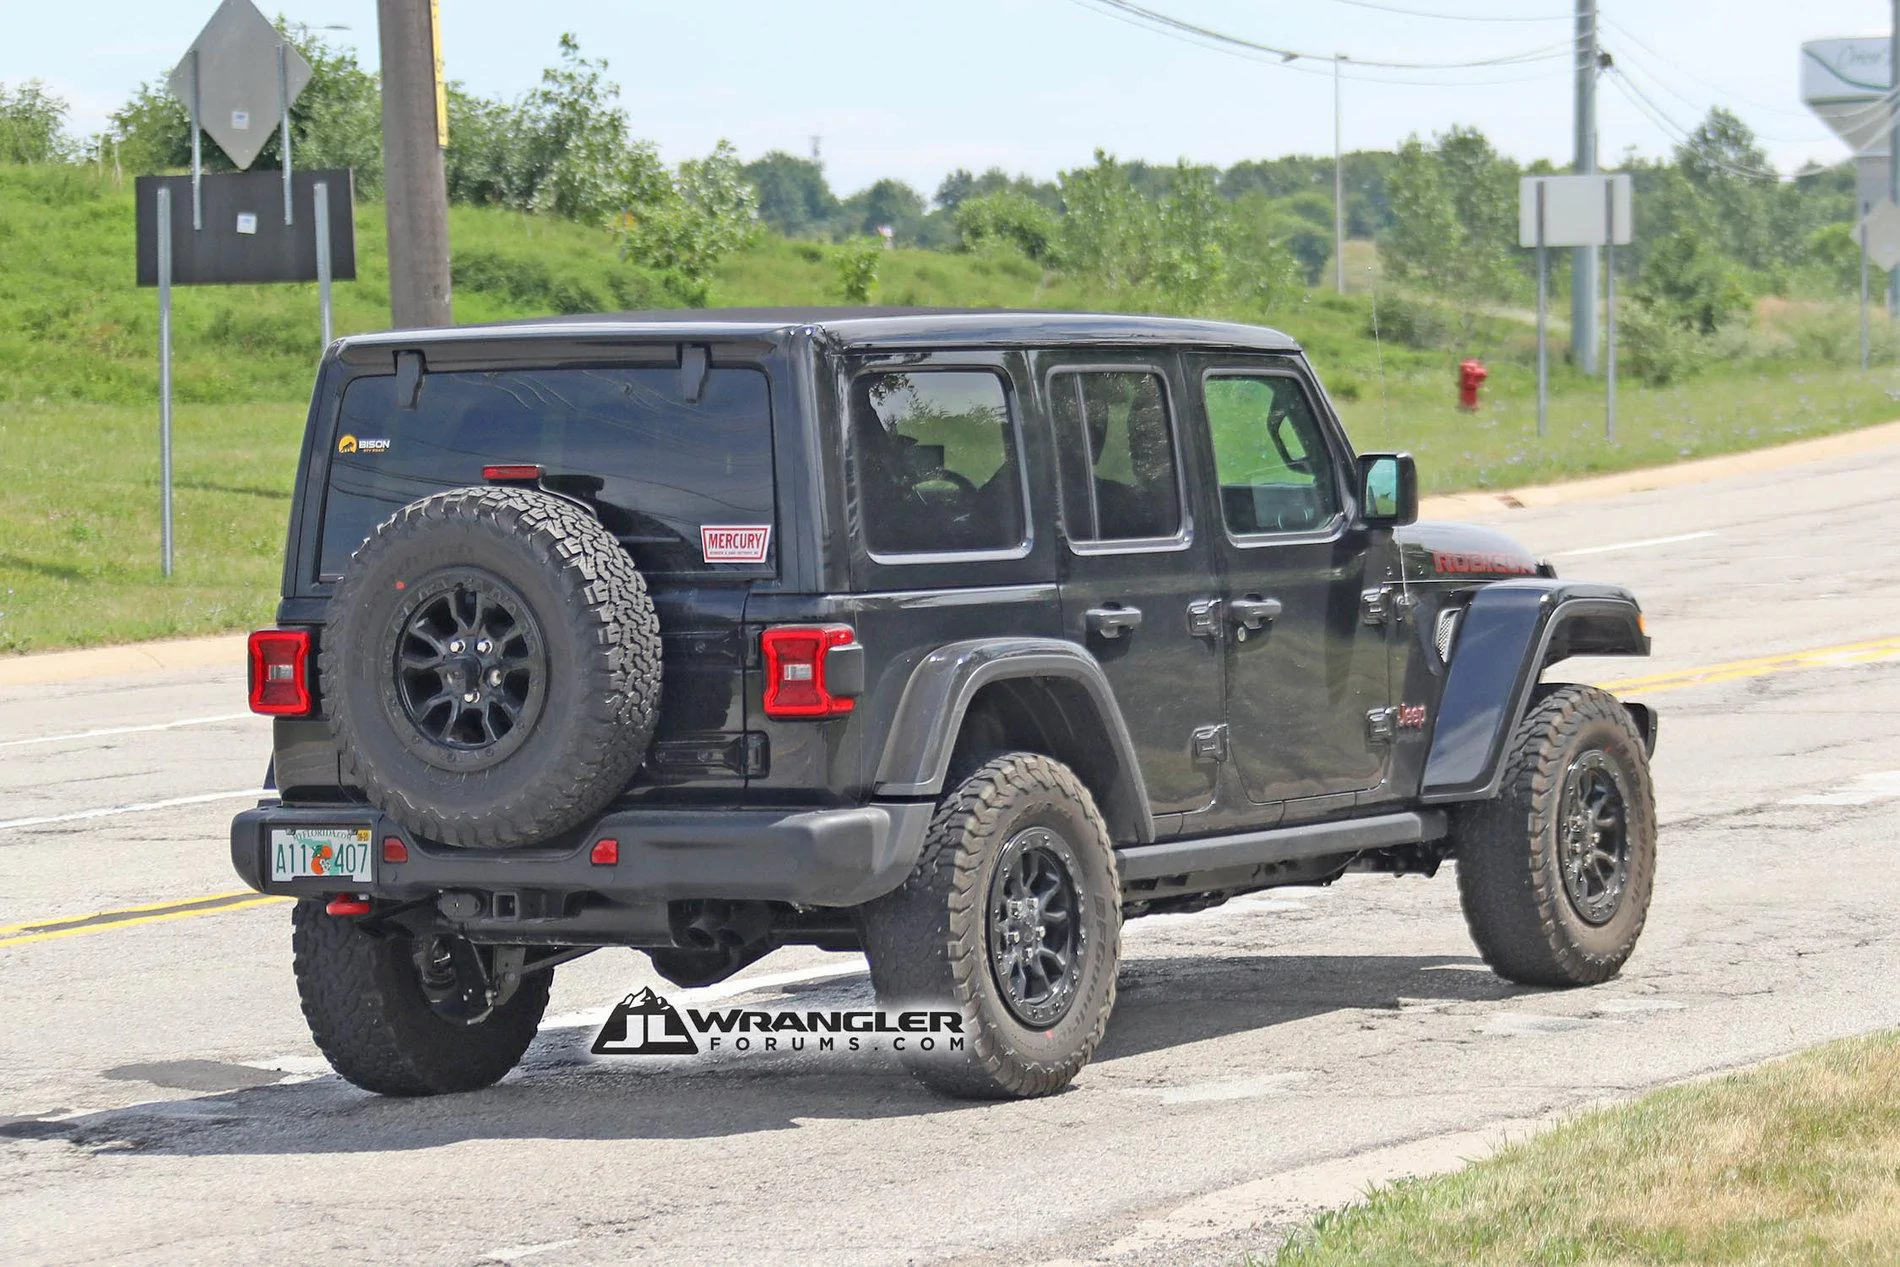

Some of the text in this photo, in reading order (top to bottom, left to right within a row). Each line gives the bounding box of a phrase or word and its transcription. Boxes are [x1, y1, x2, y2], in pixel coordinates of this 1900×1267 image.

[359, 440, 391, 449] BISON
[708, 533, 763, 549] MERCURY
[276, 843, 368, 873] A11 407
